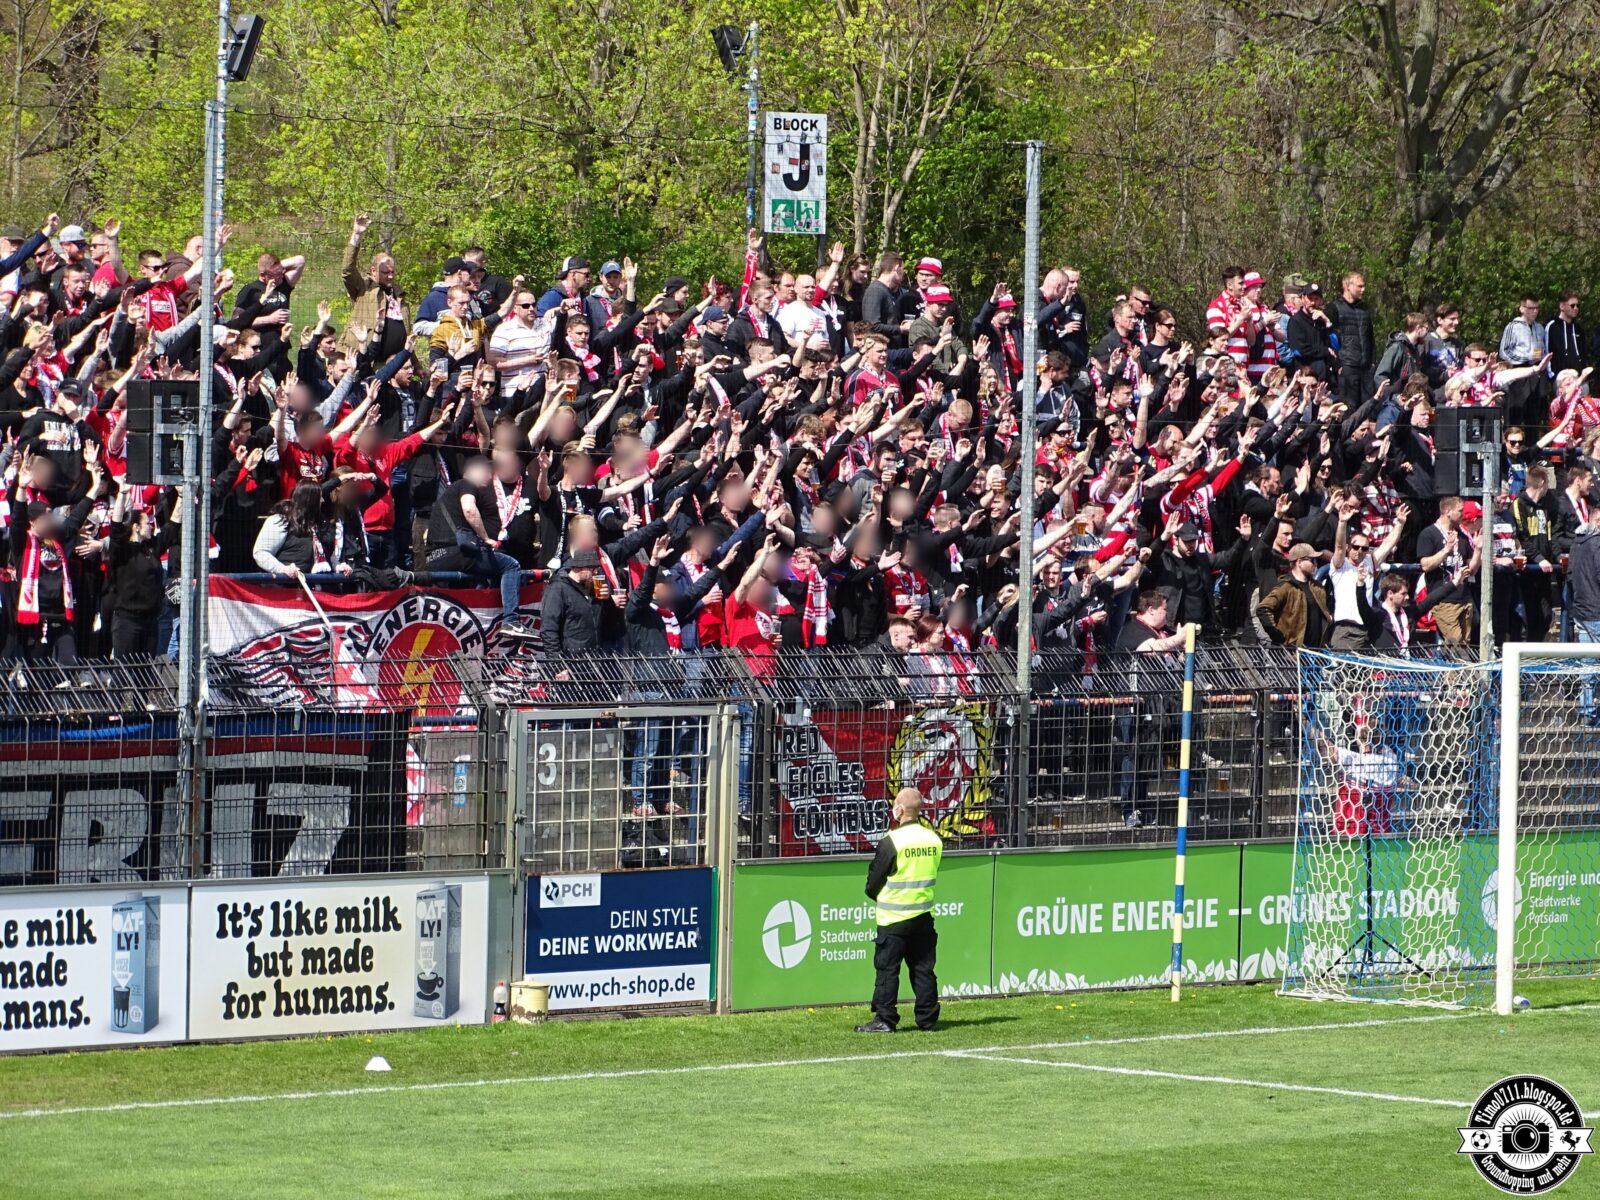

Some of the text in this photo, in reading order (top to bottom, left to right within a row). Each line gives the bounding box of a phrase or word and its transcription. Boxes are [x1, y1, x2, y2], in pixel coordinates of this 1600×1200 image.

[773, 117, 819, 132] BLOCK
[782, 143, 811, 192] J
[373, 598, 481, 657] ENERGIE
[782, 725, 820, 760] RED
[537, 742, 557, 786] 3
[787, 762, 865, 801] EAGLES
[793, 799, 890, 839] COTTBUS
[904, 846, 937, 858] ORDNER
[561, 882, 593, 898] PCH
[1529, 870, 1577, 891] Energie
[820, 902, 876, 925] Energie
[1017, 897, 1103, 937] GRÜNE
[1112, 898, 1218, 932] ENERGIE
[1259, 886, 1351, 925] GRÜNES
[1358, 887, 1457, 920] STADION
[1529, 894, 1581, 908] Stadtwerke
[26, 908, 97, 948] milk
[270, 899, 328, 937] like
[334, 895, 402, 934] milk
[420, 919, 442, 938] LY!
[610, 907, 698, 930] DEIN STYLE
[1528, 911, 1568, 924] Potsdam
[117, 932, 139, 951] LY!
[539, 930, 698, 957] DEINE WORKWEAR
[820, 946, 867, 961] Potsdam
[246, 937, 374, 978] but made
[222, 978, 395, 1020] for humans.
[548, 972, 696, 1001] ww.pch-shop.de
[0, 995, 91, 1031] mans.
